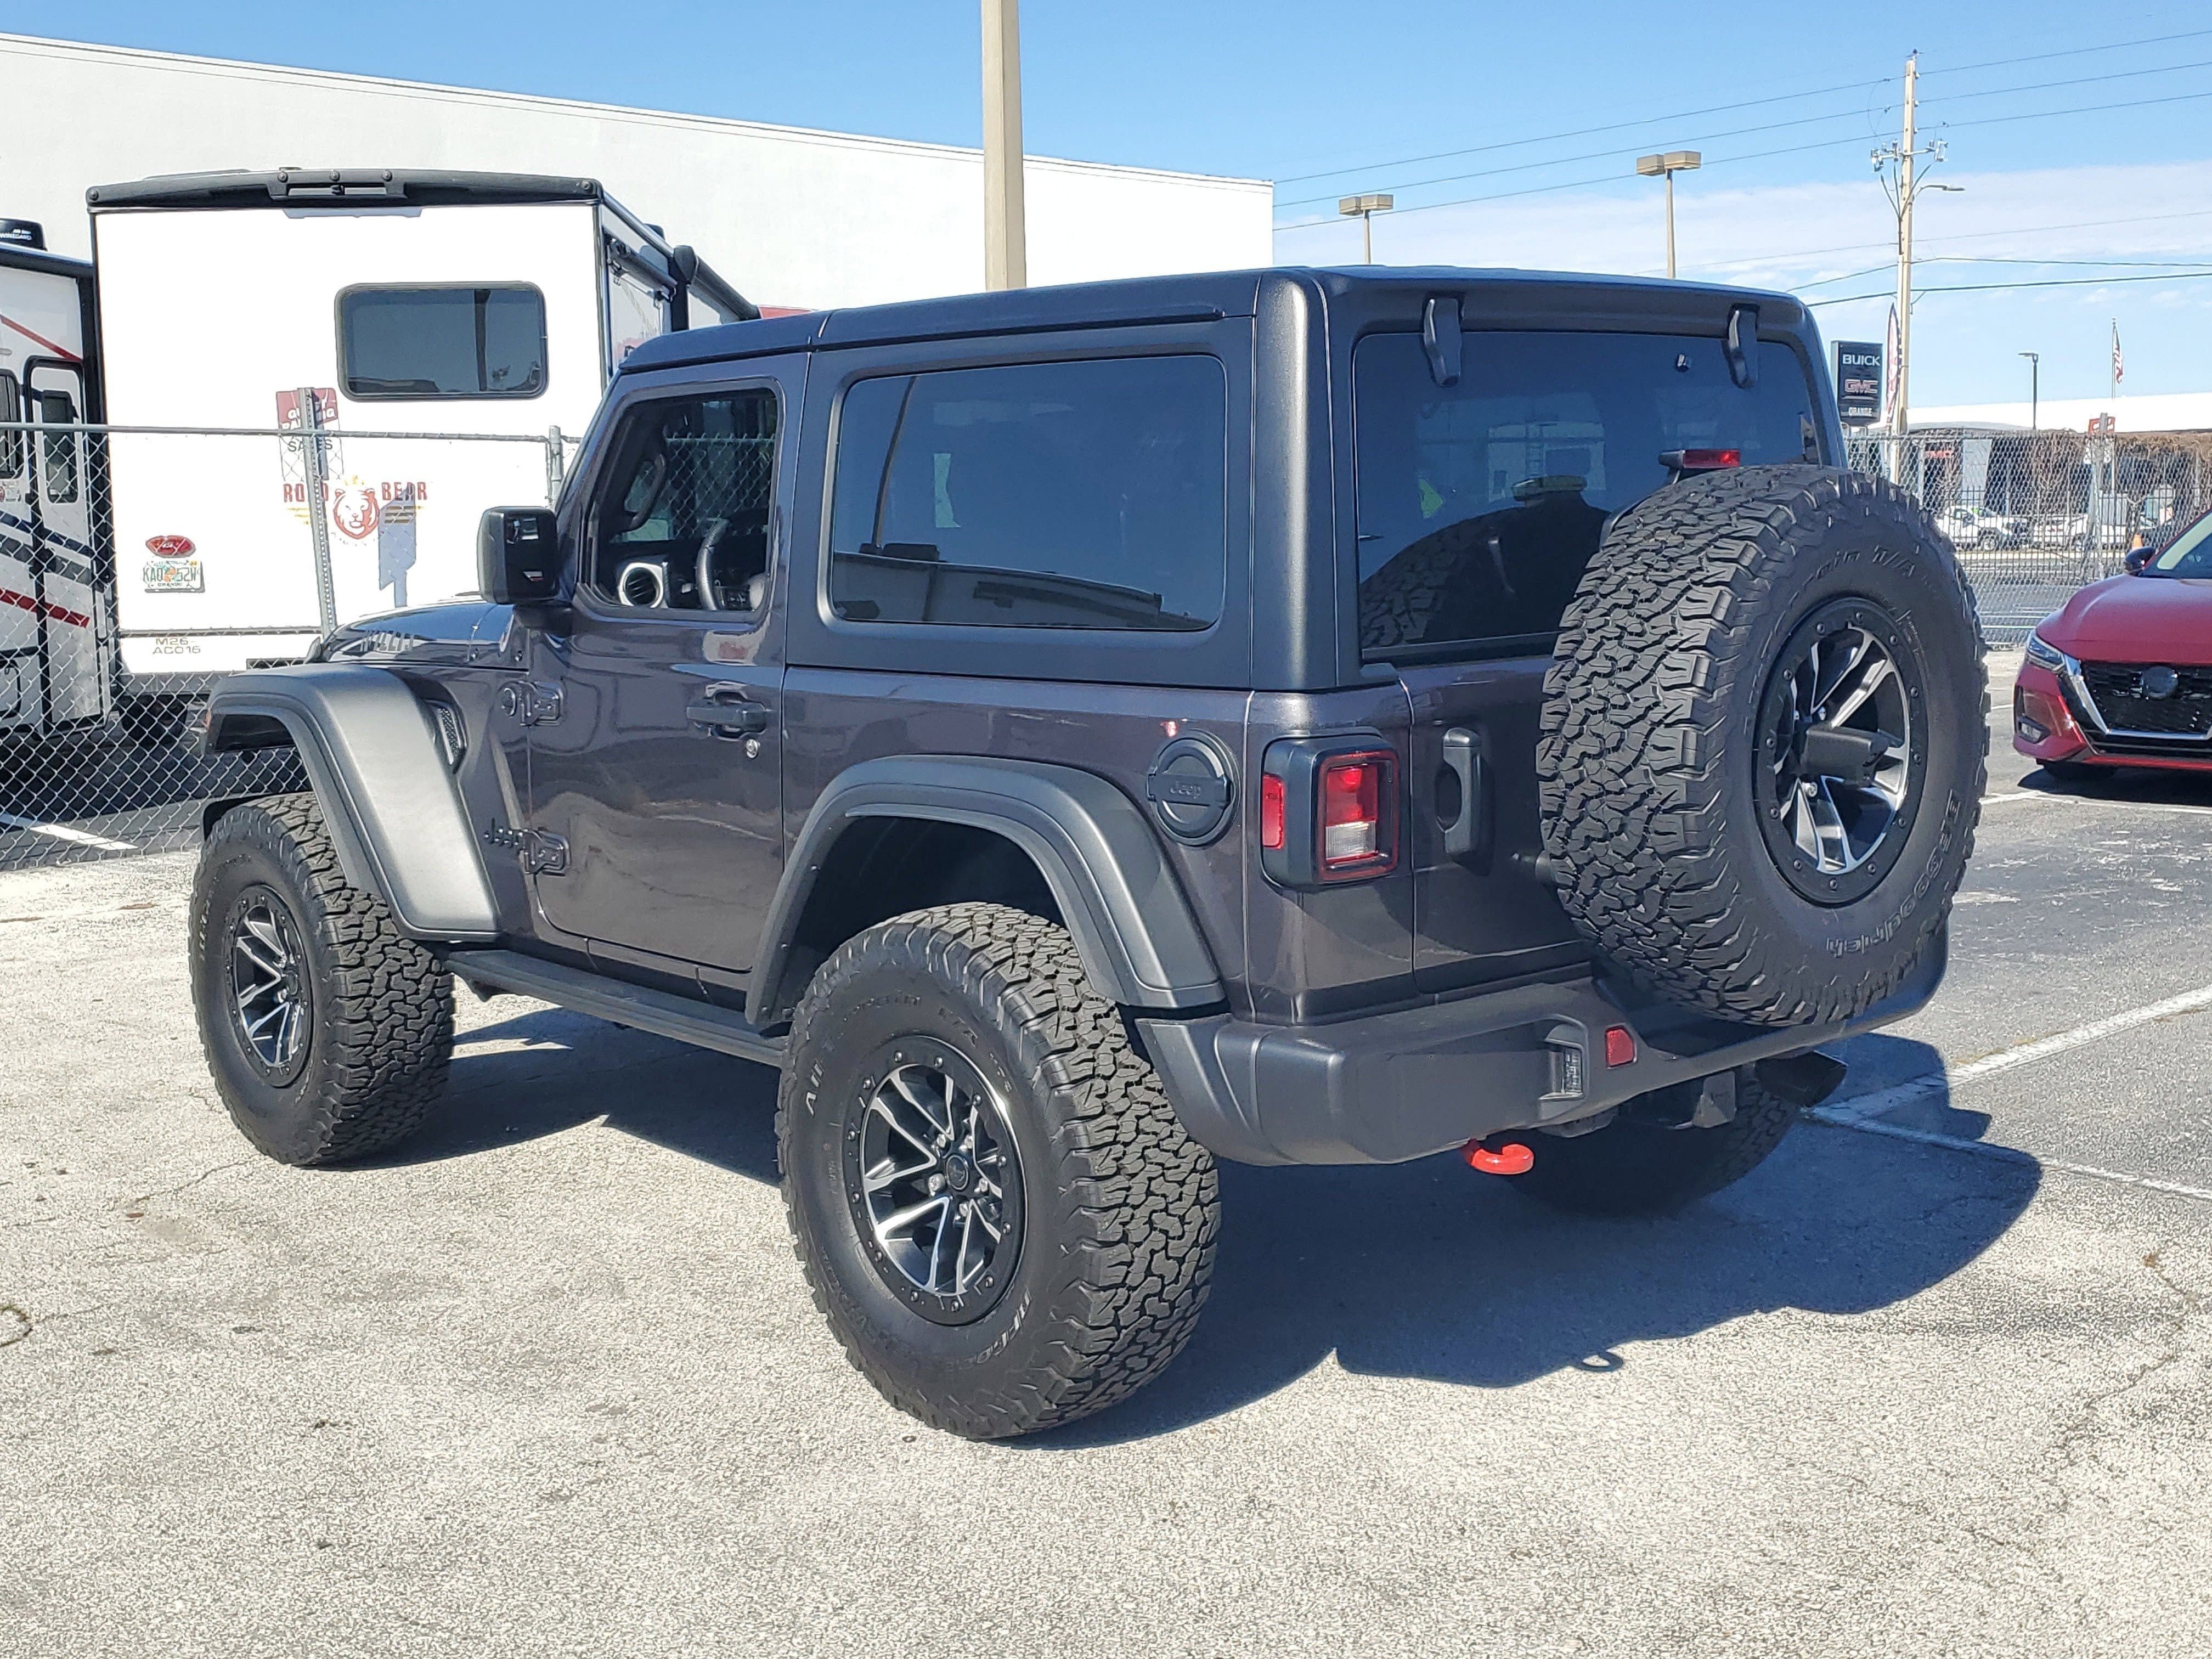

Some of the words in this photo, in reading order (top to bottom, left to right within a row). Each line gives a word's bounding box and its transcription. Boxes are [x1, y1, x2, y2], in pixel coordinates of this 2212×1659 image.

[1842, 354, 1881, 366] BUICK
[1844, 379, 1878, 393] GMC
[283, 482, 329, 502] ROD
[381, 482, 427, 500] BEAR
[1170, 780, 1201, 799] Jeep
